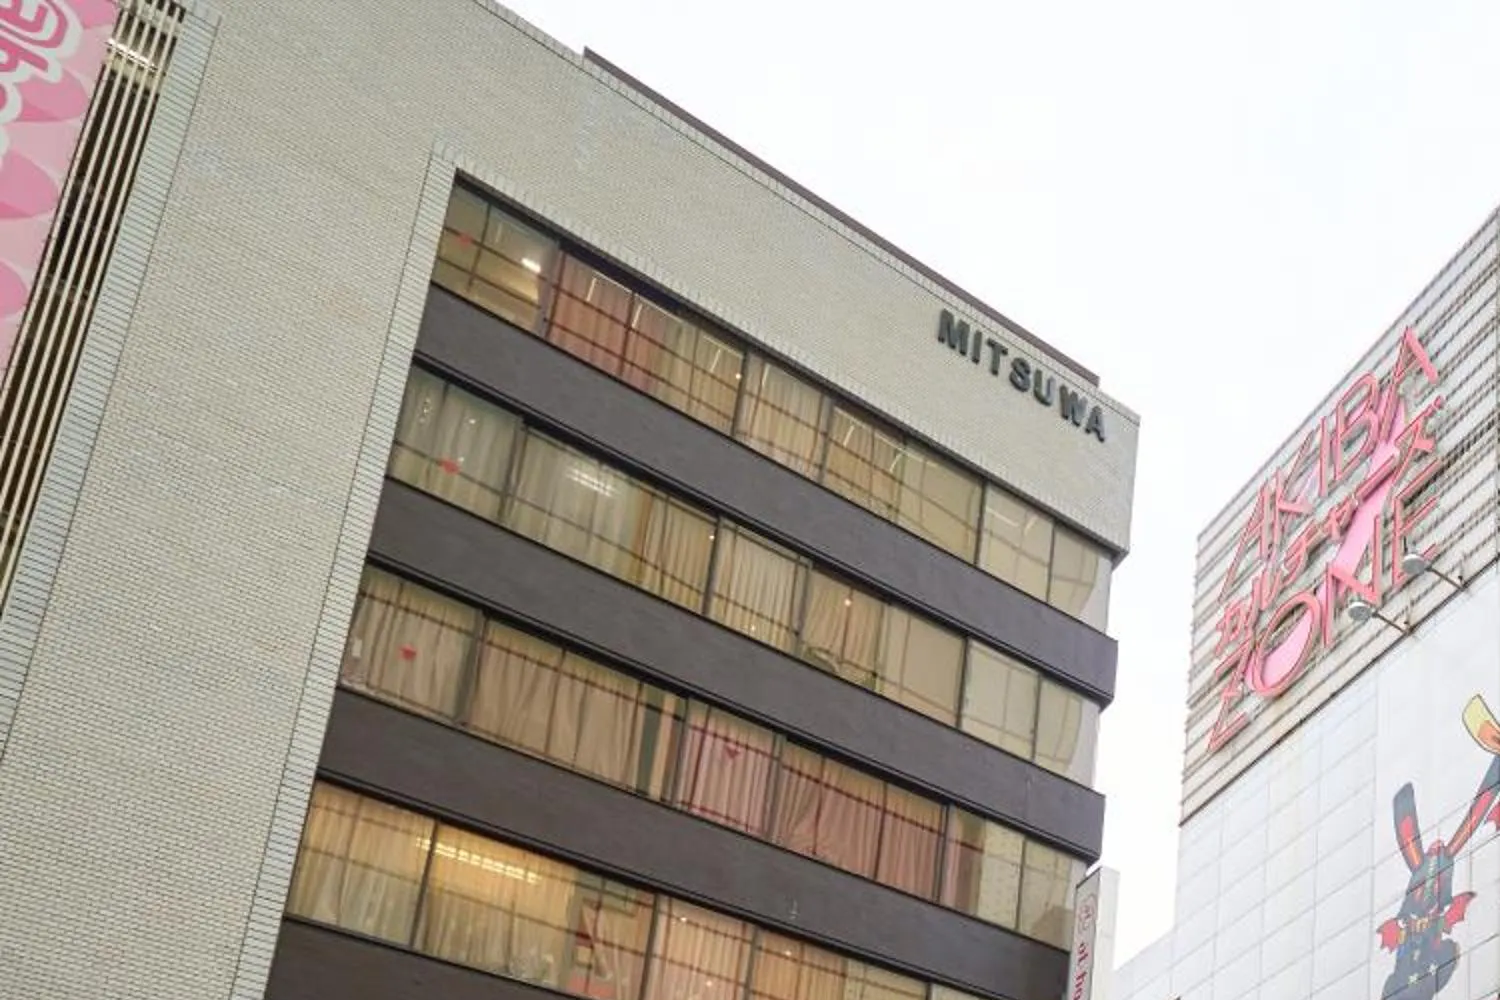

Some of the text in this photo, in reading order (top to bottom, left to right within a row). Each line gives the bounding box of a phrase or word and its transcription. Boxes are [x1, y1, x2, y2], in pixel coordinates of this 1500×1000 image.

[937, 308, 1105, 443] MITSUWA
[1218, 326, 1439, 602] AKIBA
[1207, 456, 1443, 752] ZONE
